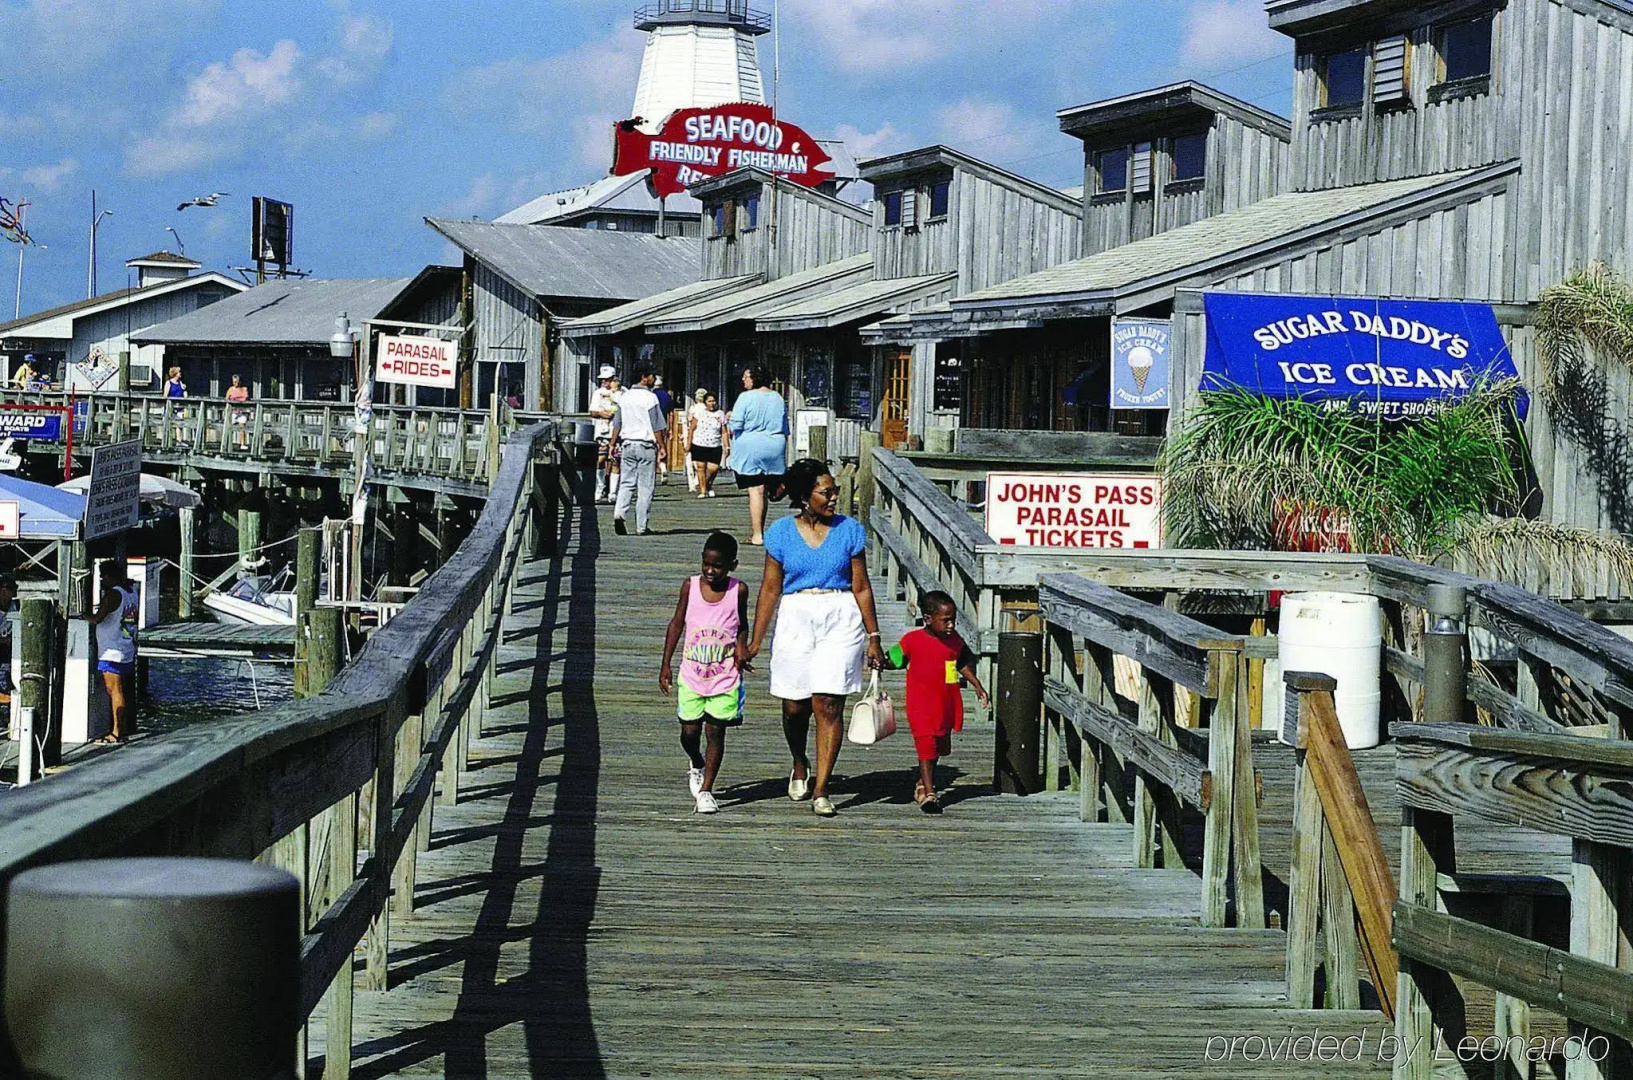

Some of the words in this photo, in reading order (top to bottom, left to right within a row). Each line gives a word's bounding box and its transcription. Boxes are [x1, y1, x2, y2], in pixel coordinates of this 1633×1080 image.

[685, 115, 784, 149] SEAFOOD
[649, 141, 722, 166] FRIENDLY
[728, 148, 808, 174] FISHERMAN
[1114, 326, 1137, 343] SUGAR
[1139, 325, 1168, 344] DADDY'S
[1253, 310, 1350, 351] SUGAR
[1350, 310, 1470, 359] DADDY'S
[387, 342, 448, 361] PARASAIL
[1117, 340, 1133, 354] ICE
[1134, 338, 1165, 354] CREAM
[393, 360, 440, 377] RIDES
[1277, 361, 1337, 385] ICE
[1345, 362, 1471, 390] CREAM
[1117, 388, 1140, 403] FROZEN
[1143, 388, 1165, 403] YOGURT
[1358, 401, 1401, 415] SWEET
[997, 483, 1082, 504] JOHN'S
[1095, 485, 1154, 505] PASS
[1017, 506, 1130, 528] PARASAIL
[1025, 529, 1124, 548] TICKETS
[694, 629, 727, 640] SURF
